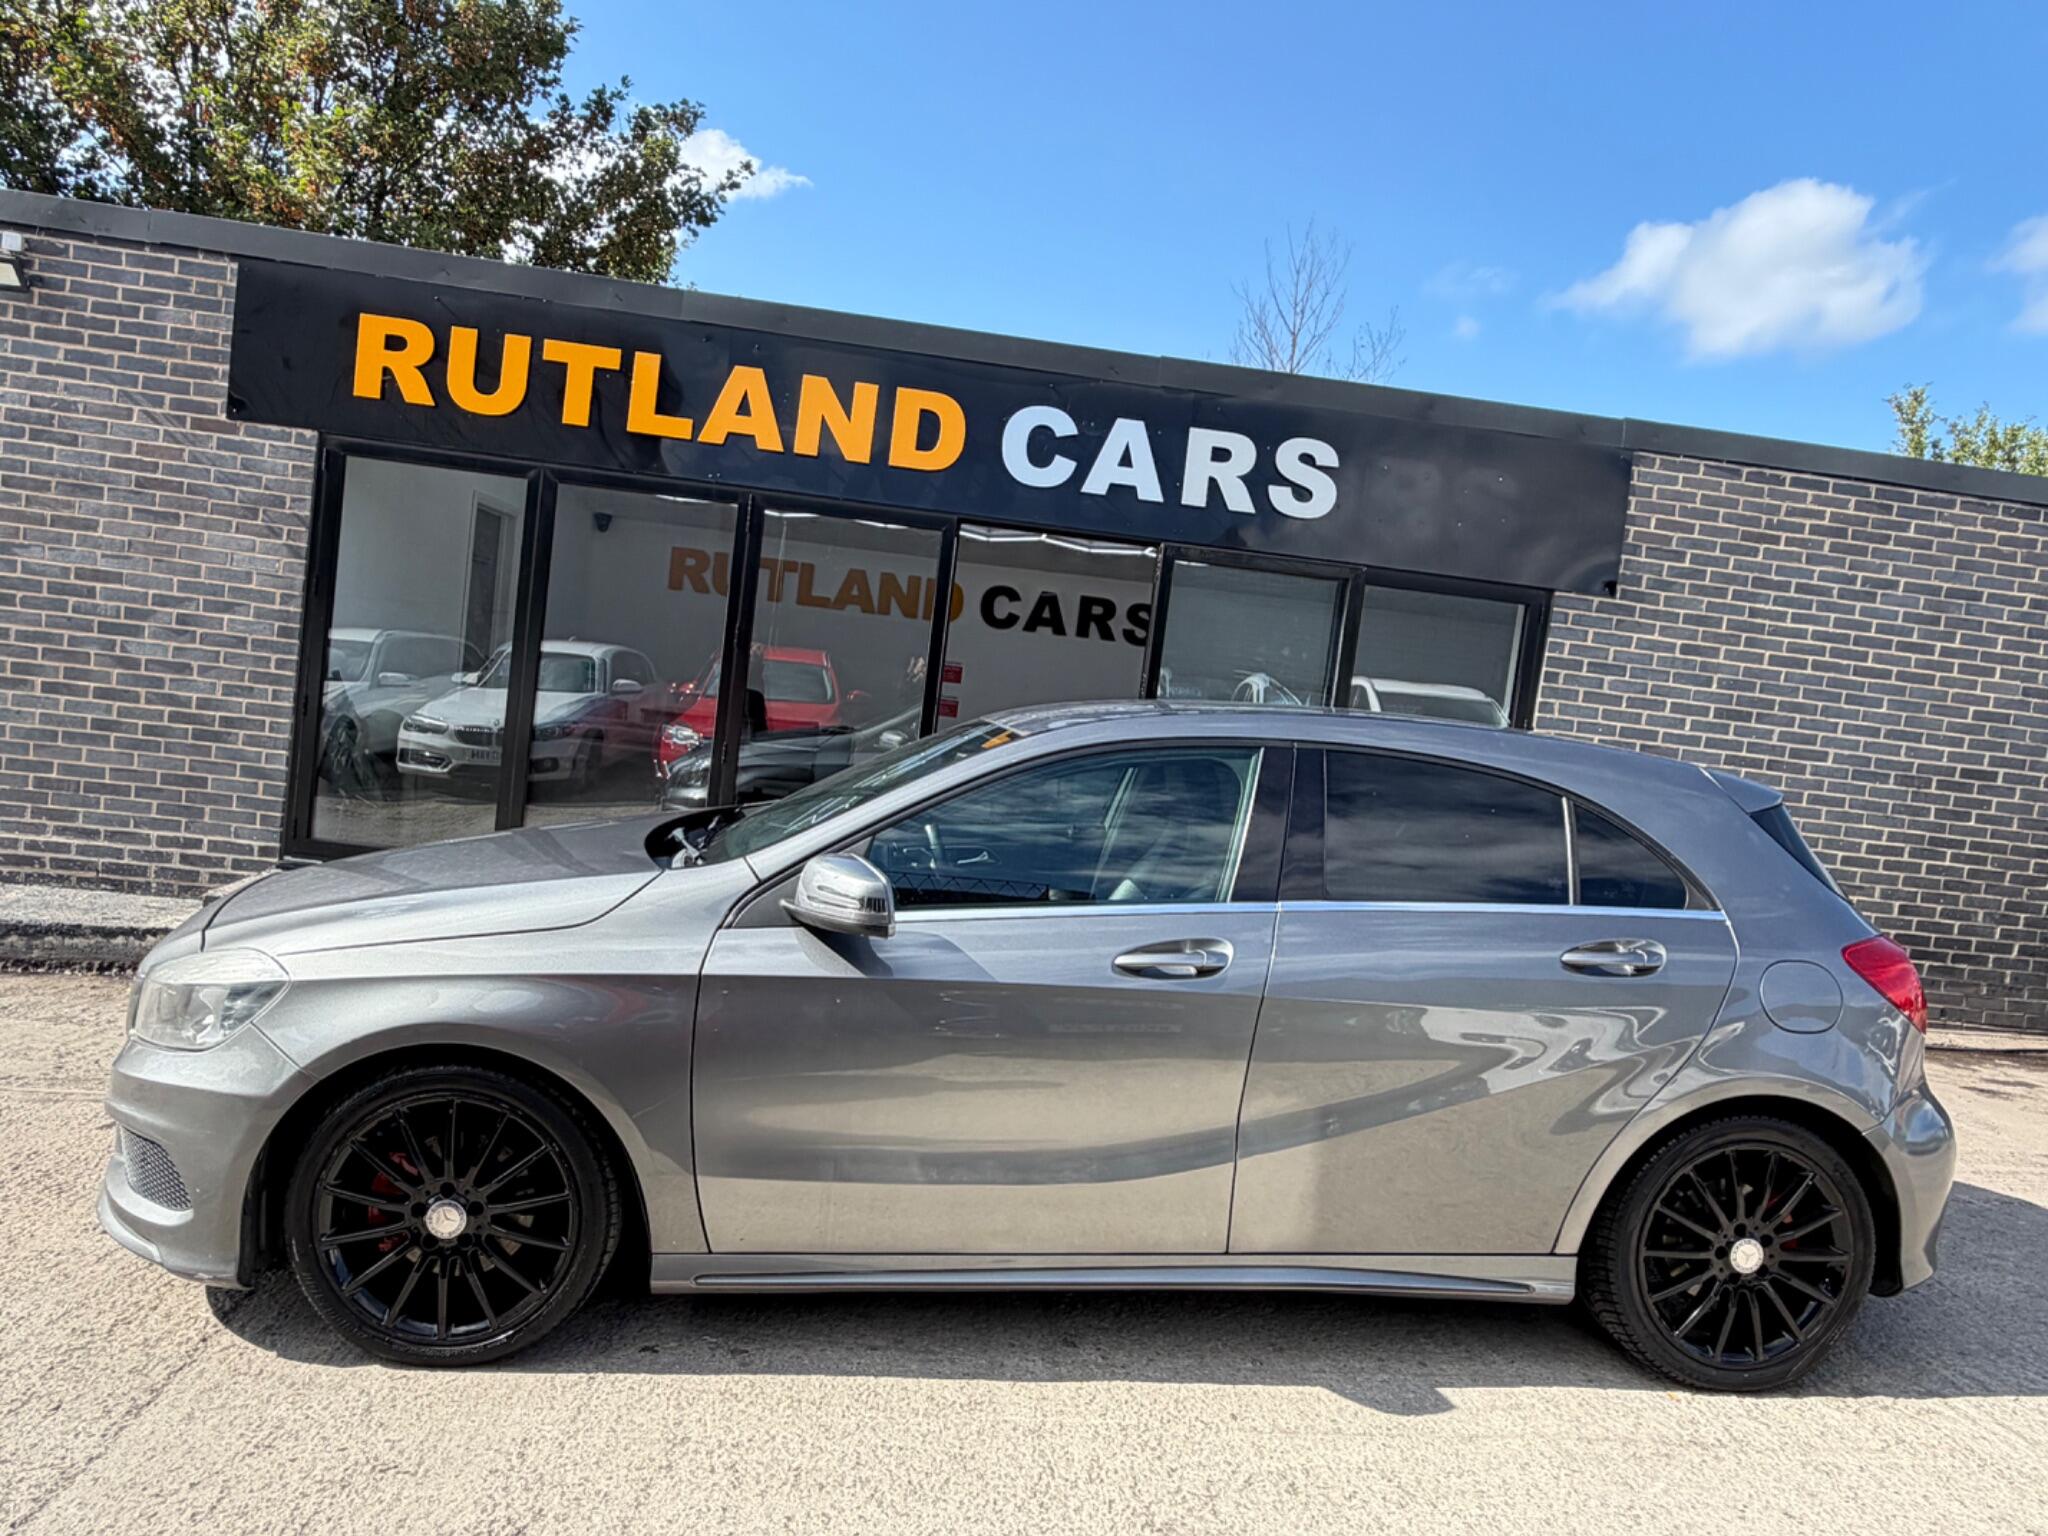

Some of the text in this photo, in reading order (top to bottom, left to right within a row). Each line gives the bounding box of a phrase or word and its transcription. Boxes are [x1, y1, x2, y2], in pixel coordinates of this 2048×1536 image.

[352, 312, 1340, 519] RUTLAND CARS
[980, 585, 1152, 647] CARS
